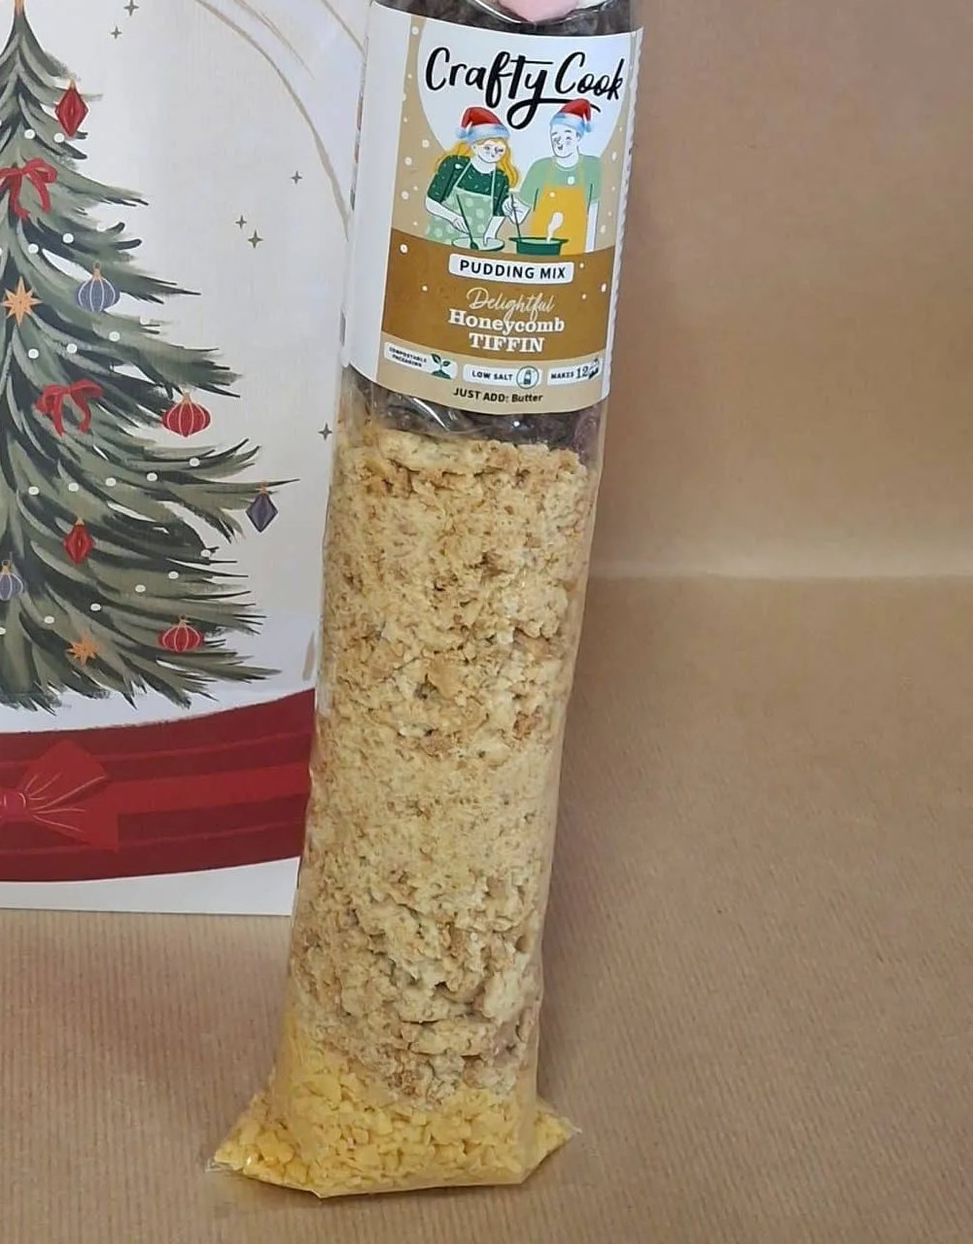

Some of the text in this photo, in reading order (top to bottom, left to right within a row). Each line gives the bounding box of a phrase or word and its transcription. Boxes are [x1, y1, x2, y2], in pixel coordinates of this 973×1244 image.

[424, 47, 625, 130] Crafty Cook
[459, 259, 567, 280] PUDDING MIX
[466, 286, 556, 322] Delightful
[448, 308, 565, 336] Honeycomb
[468, 332, 546, 353] TIFFIN
[471, 369, 513, 381] LOW SALT
[550, 365, 589, 380] MAKES 12
[453, 387, 543, 403] JUST ADD: Butter
